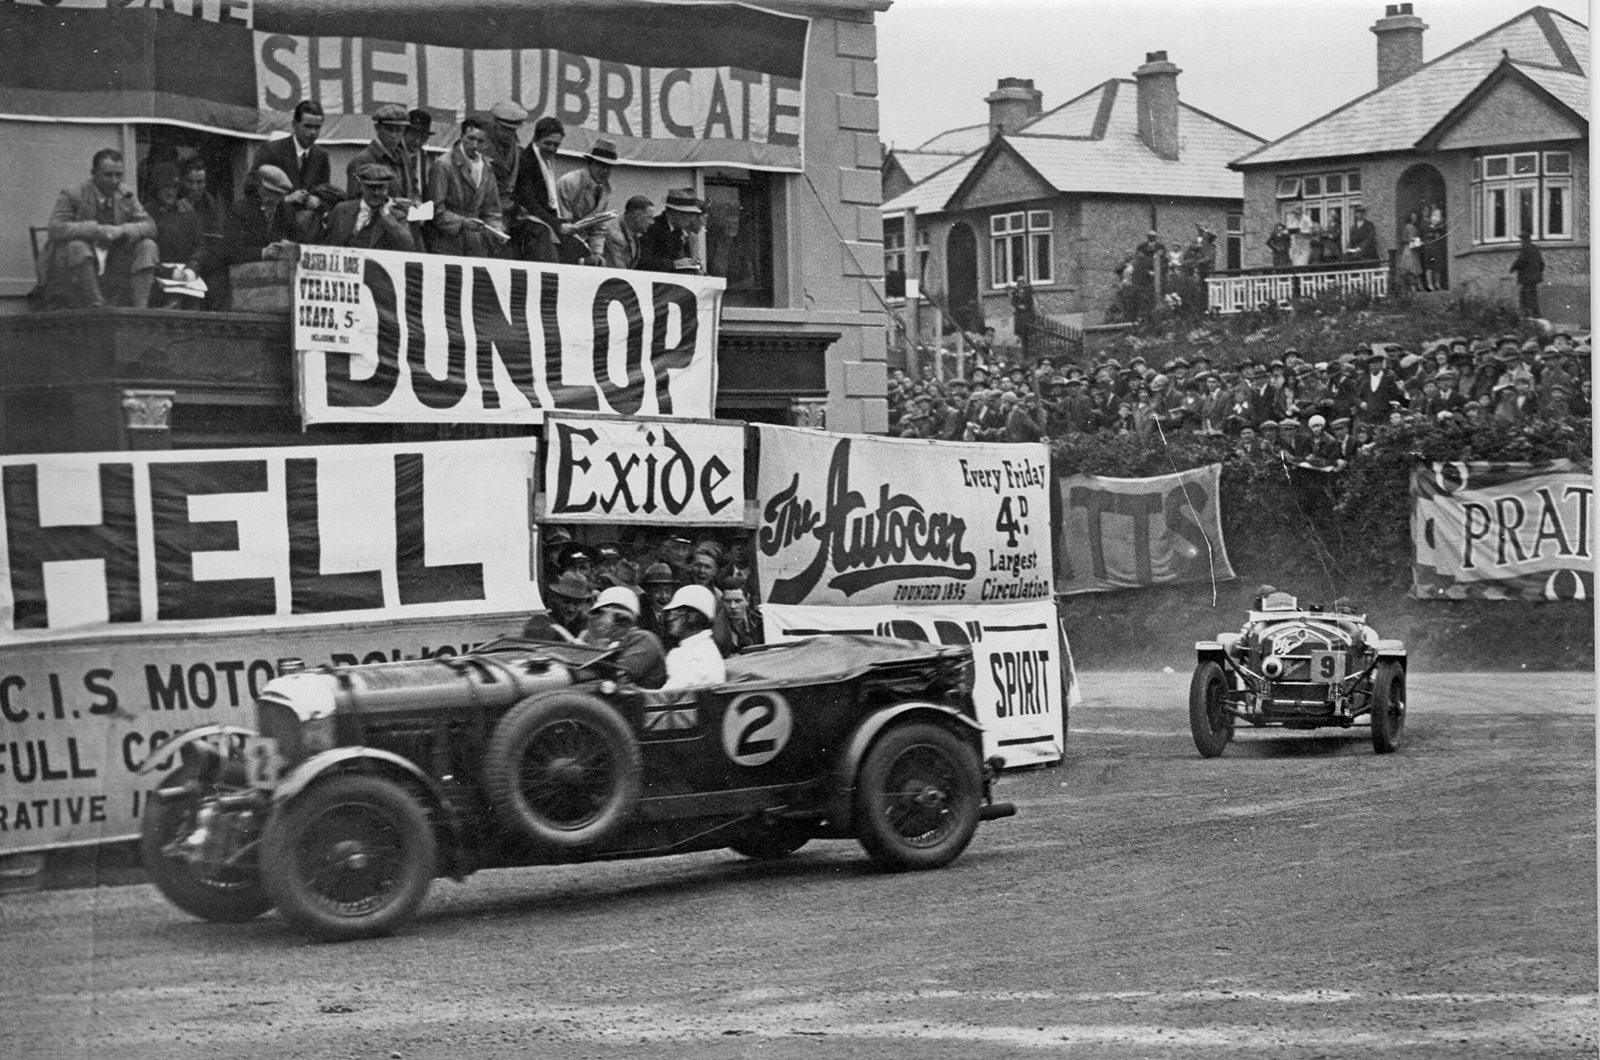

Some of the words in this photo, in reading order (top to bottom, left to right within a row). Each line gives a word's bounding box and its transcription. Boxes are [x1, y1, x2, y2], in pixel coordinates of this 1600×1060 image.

[300, 278, 360, 305] VERANDAH
[325, 258, 699, 415] DUNLOP
[551, 422, 735, 516] Exide
[959, 459, 1001, 494] Every
[1002, 459, 1045, 489] Friday
[759, 472, 821, 557] The
[767, 437, 976, 605] Autocar
[989, 549, 1037, 577] Largest
[893, 585, 941, 601] FOUNDED
[981, 576, 1050, 600] Circulation
[989, 650, 1050, 718] SPIRIT
[1320, 655, 1335, 678] 9
[735, 693, 778, 757] 2
